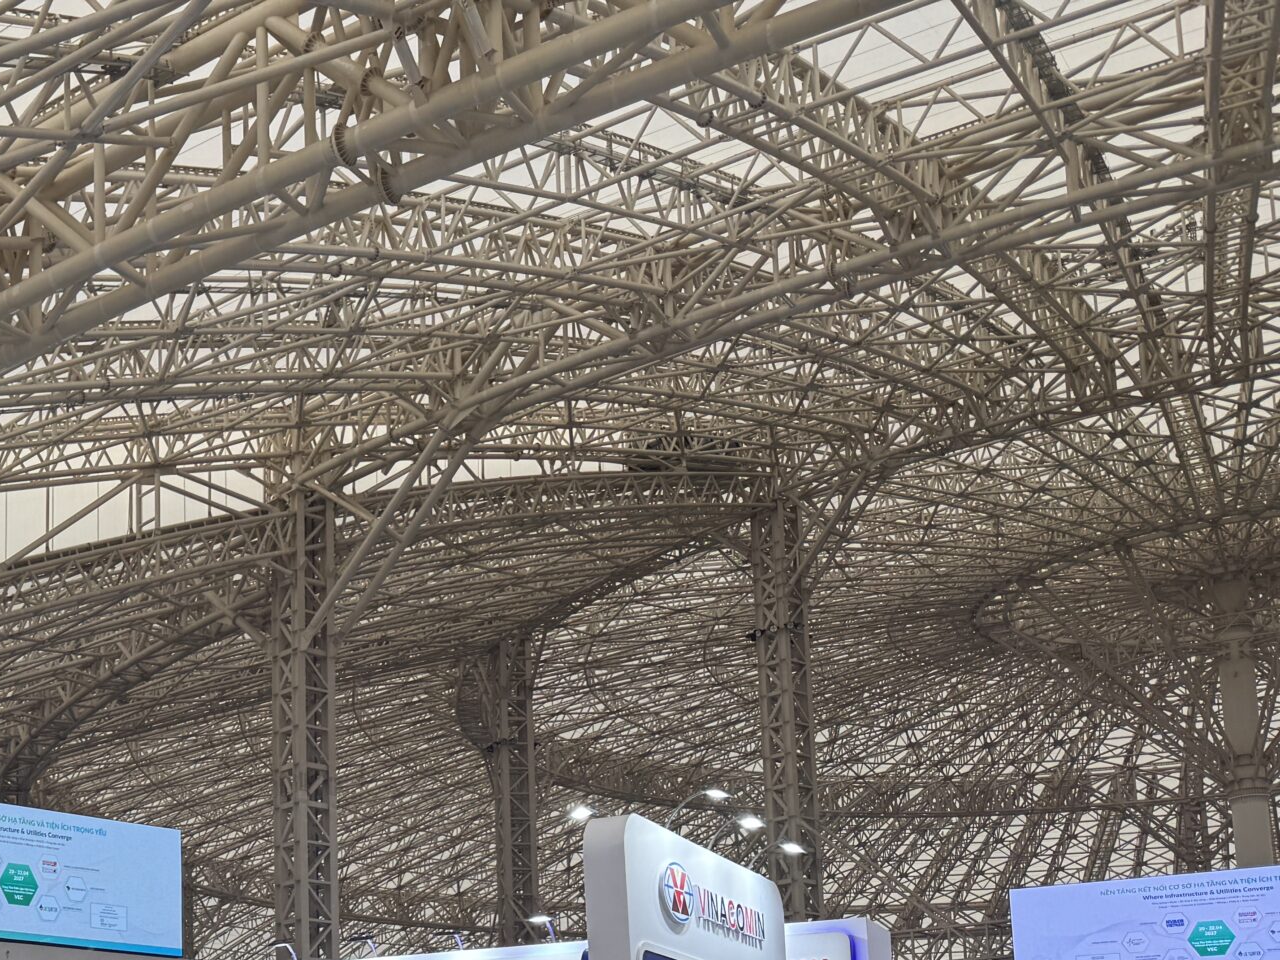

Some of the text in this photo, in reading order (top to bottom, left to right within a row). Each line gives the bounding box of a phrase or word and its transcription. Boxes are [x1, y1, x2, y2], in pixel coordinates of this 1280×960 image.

[26, 828, 47, 838] Utilities
[48, 831, 72, 842] Converge
[1164, 891, 1208, 900] Infrastructure
[1216, 888, 1242, 896] Utilities
[1242, 886, 1274, 894] Converge
[696, 885, 765, 939] VINACOMIN
